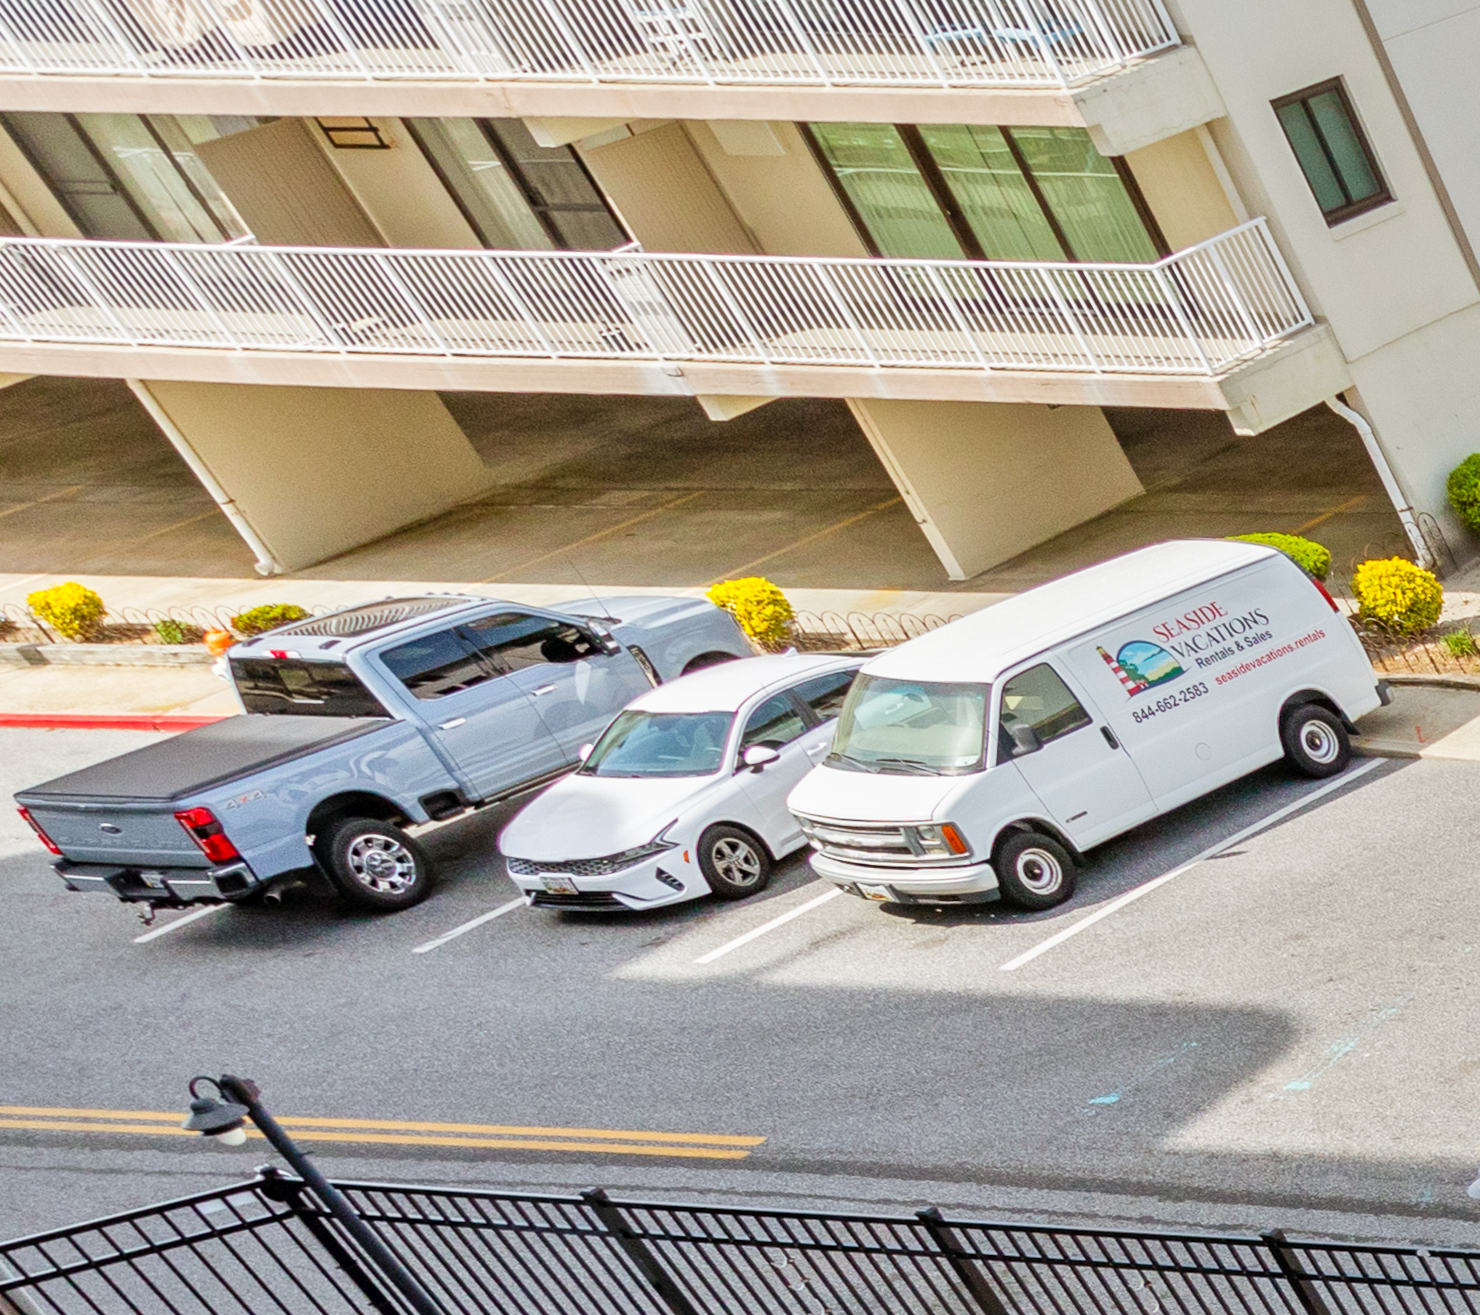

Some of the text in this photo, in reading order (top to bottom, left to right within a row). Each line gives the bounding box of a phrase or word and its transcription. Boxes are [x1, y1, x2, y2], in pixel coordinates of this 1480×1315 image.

[1152, 601, 1229, 643] SEASIDE
[1170, 608, 1270, 659] VACATIONS
[1195, 629, 1273, 669] Rentals & Sales
[1215, 628, 1326, 686] seasidevacations.rentals
[1132, 682, 1210, 724] 844-662-2583
